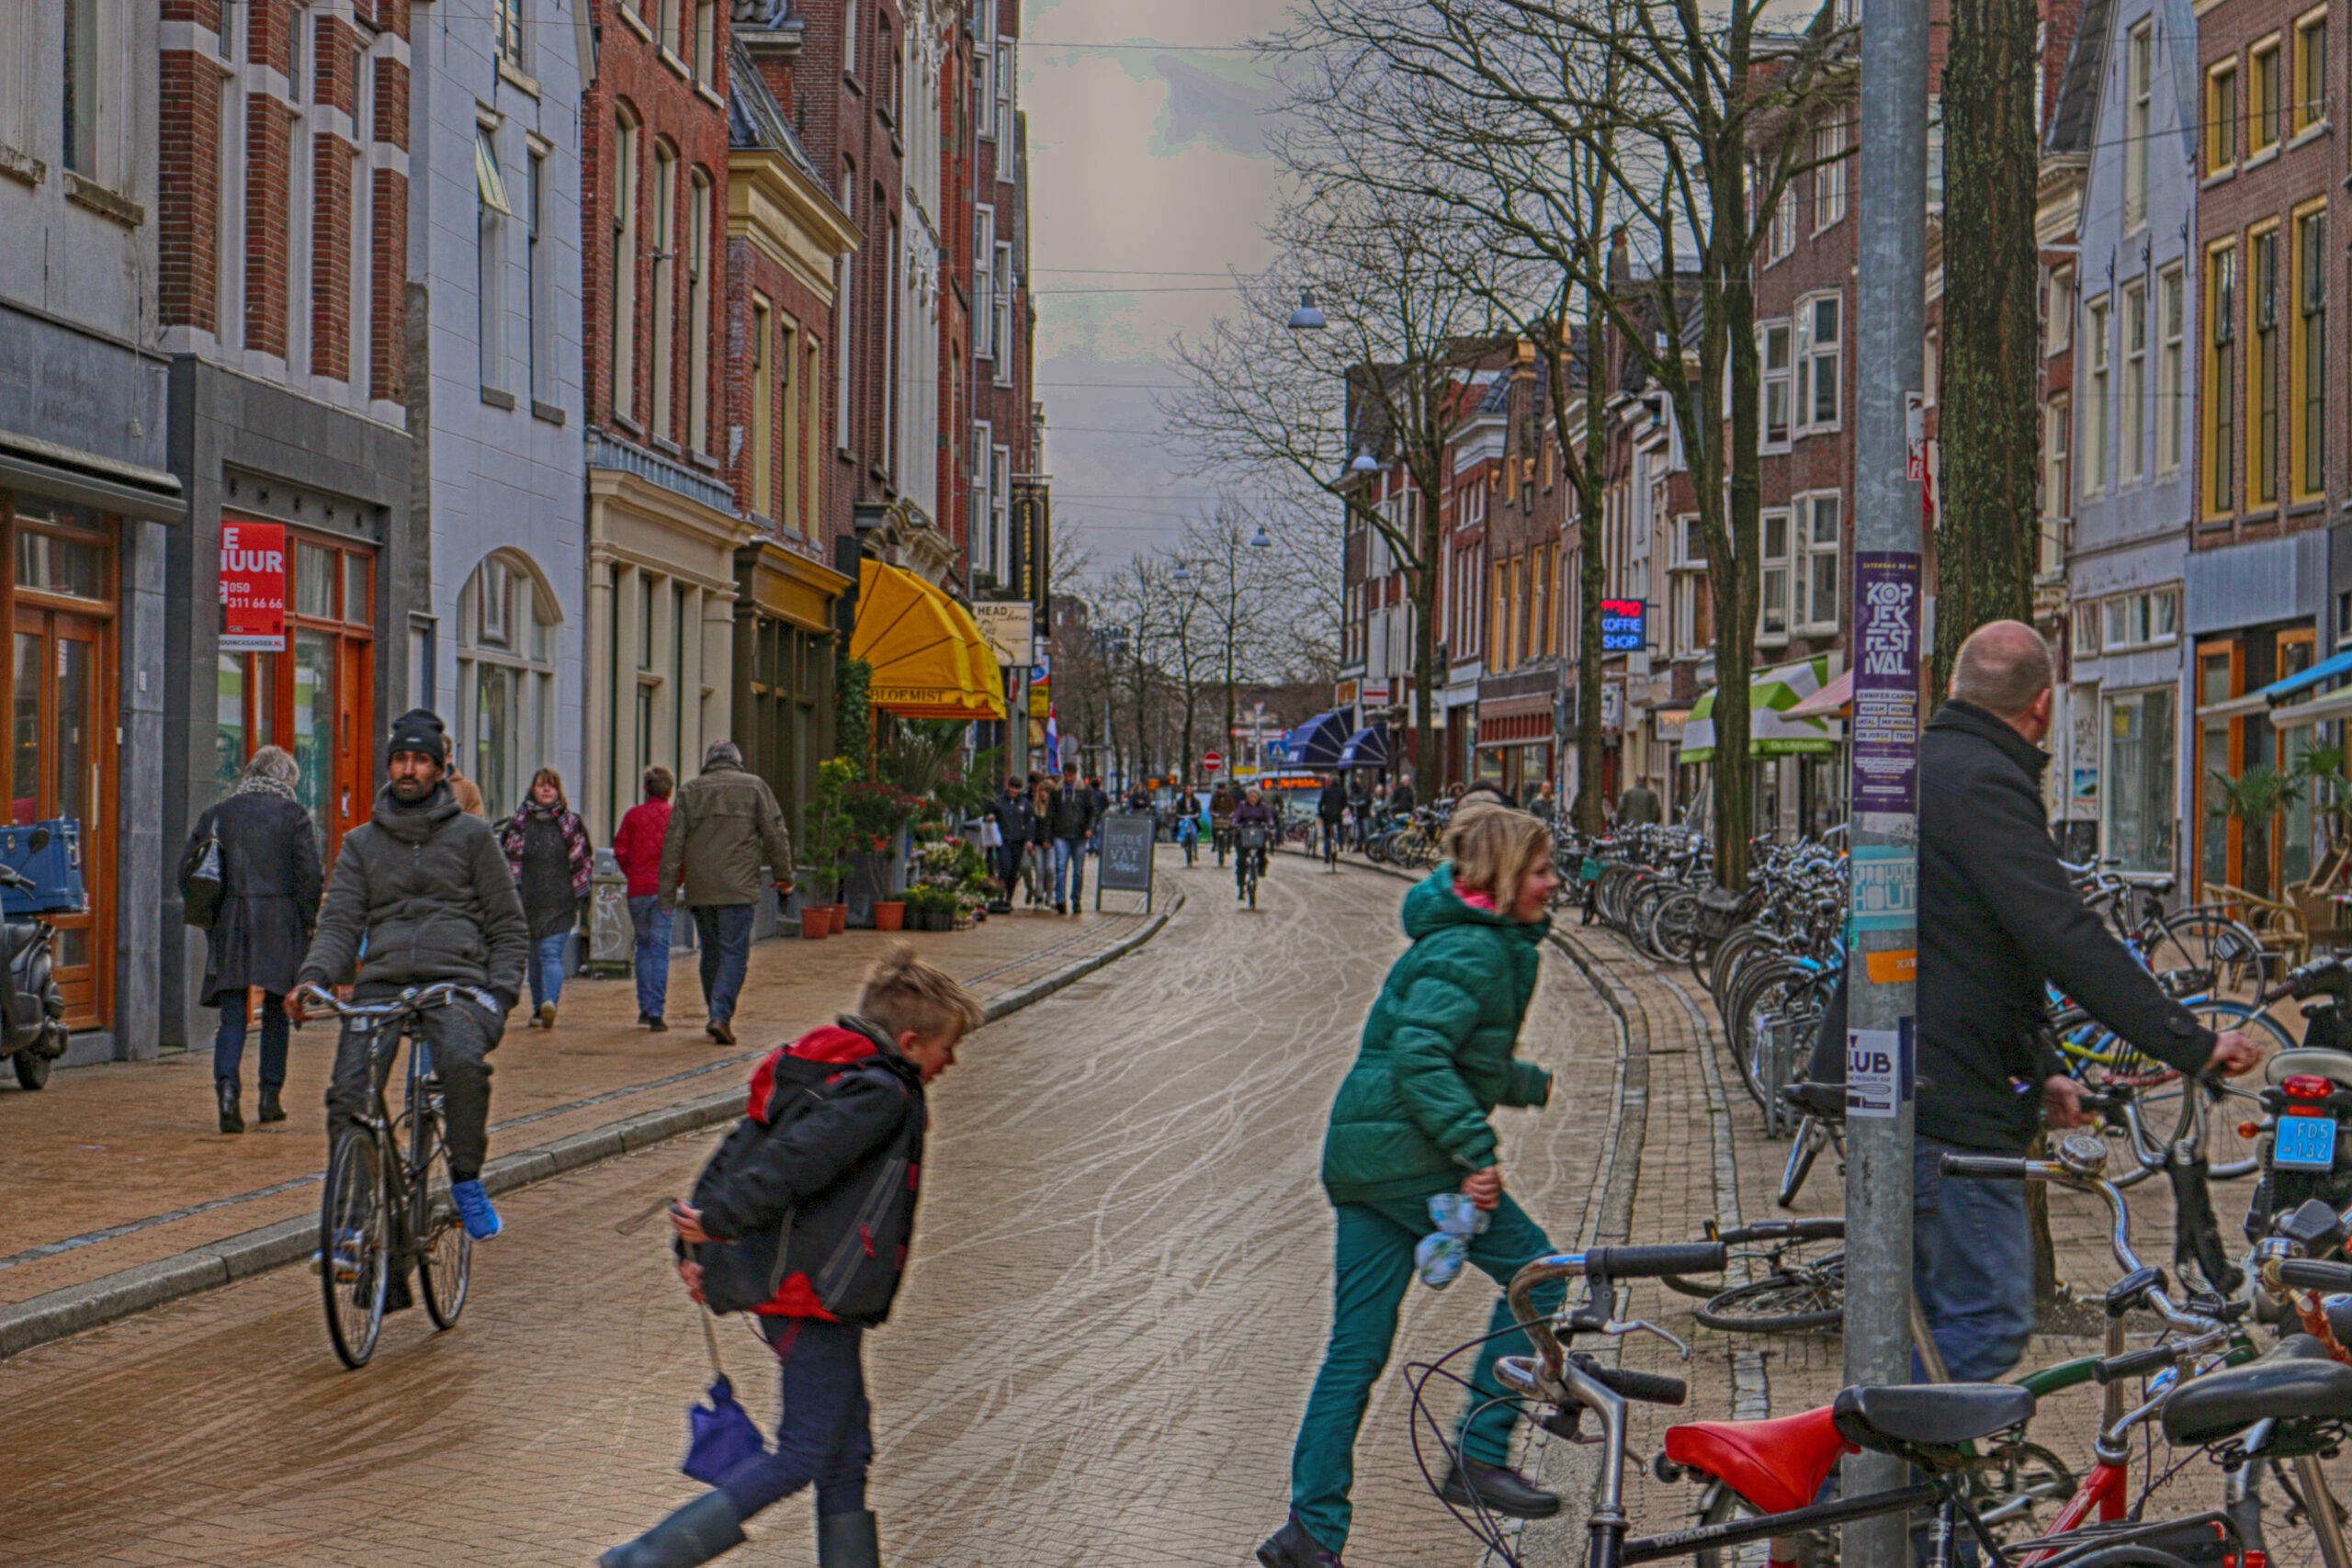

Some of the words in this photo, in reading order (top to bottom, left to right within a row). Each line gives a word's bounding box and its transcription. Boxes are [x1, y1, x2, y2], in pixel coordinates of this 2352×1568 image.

[229, 582, 250, 593] 050
[1867, 582, 1914, 605] KOP
[229, 597, 250, 608] 311
[253, 597, 266, 609] 66
[268, 597, 283, 609] 66
[978, 605, 1008, 616] HEAD
[1869, 605, 1911, 629] JEK
[1603, 635, 1640, 649] SHOP
[1865, 629, 1912, 651] FEST
[870, 689, 945, 703] BLOEMIST
[1853, 884, 1916, 910] HOUT
[1652, 1525, 1728, 1549] VOYAGER
